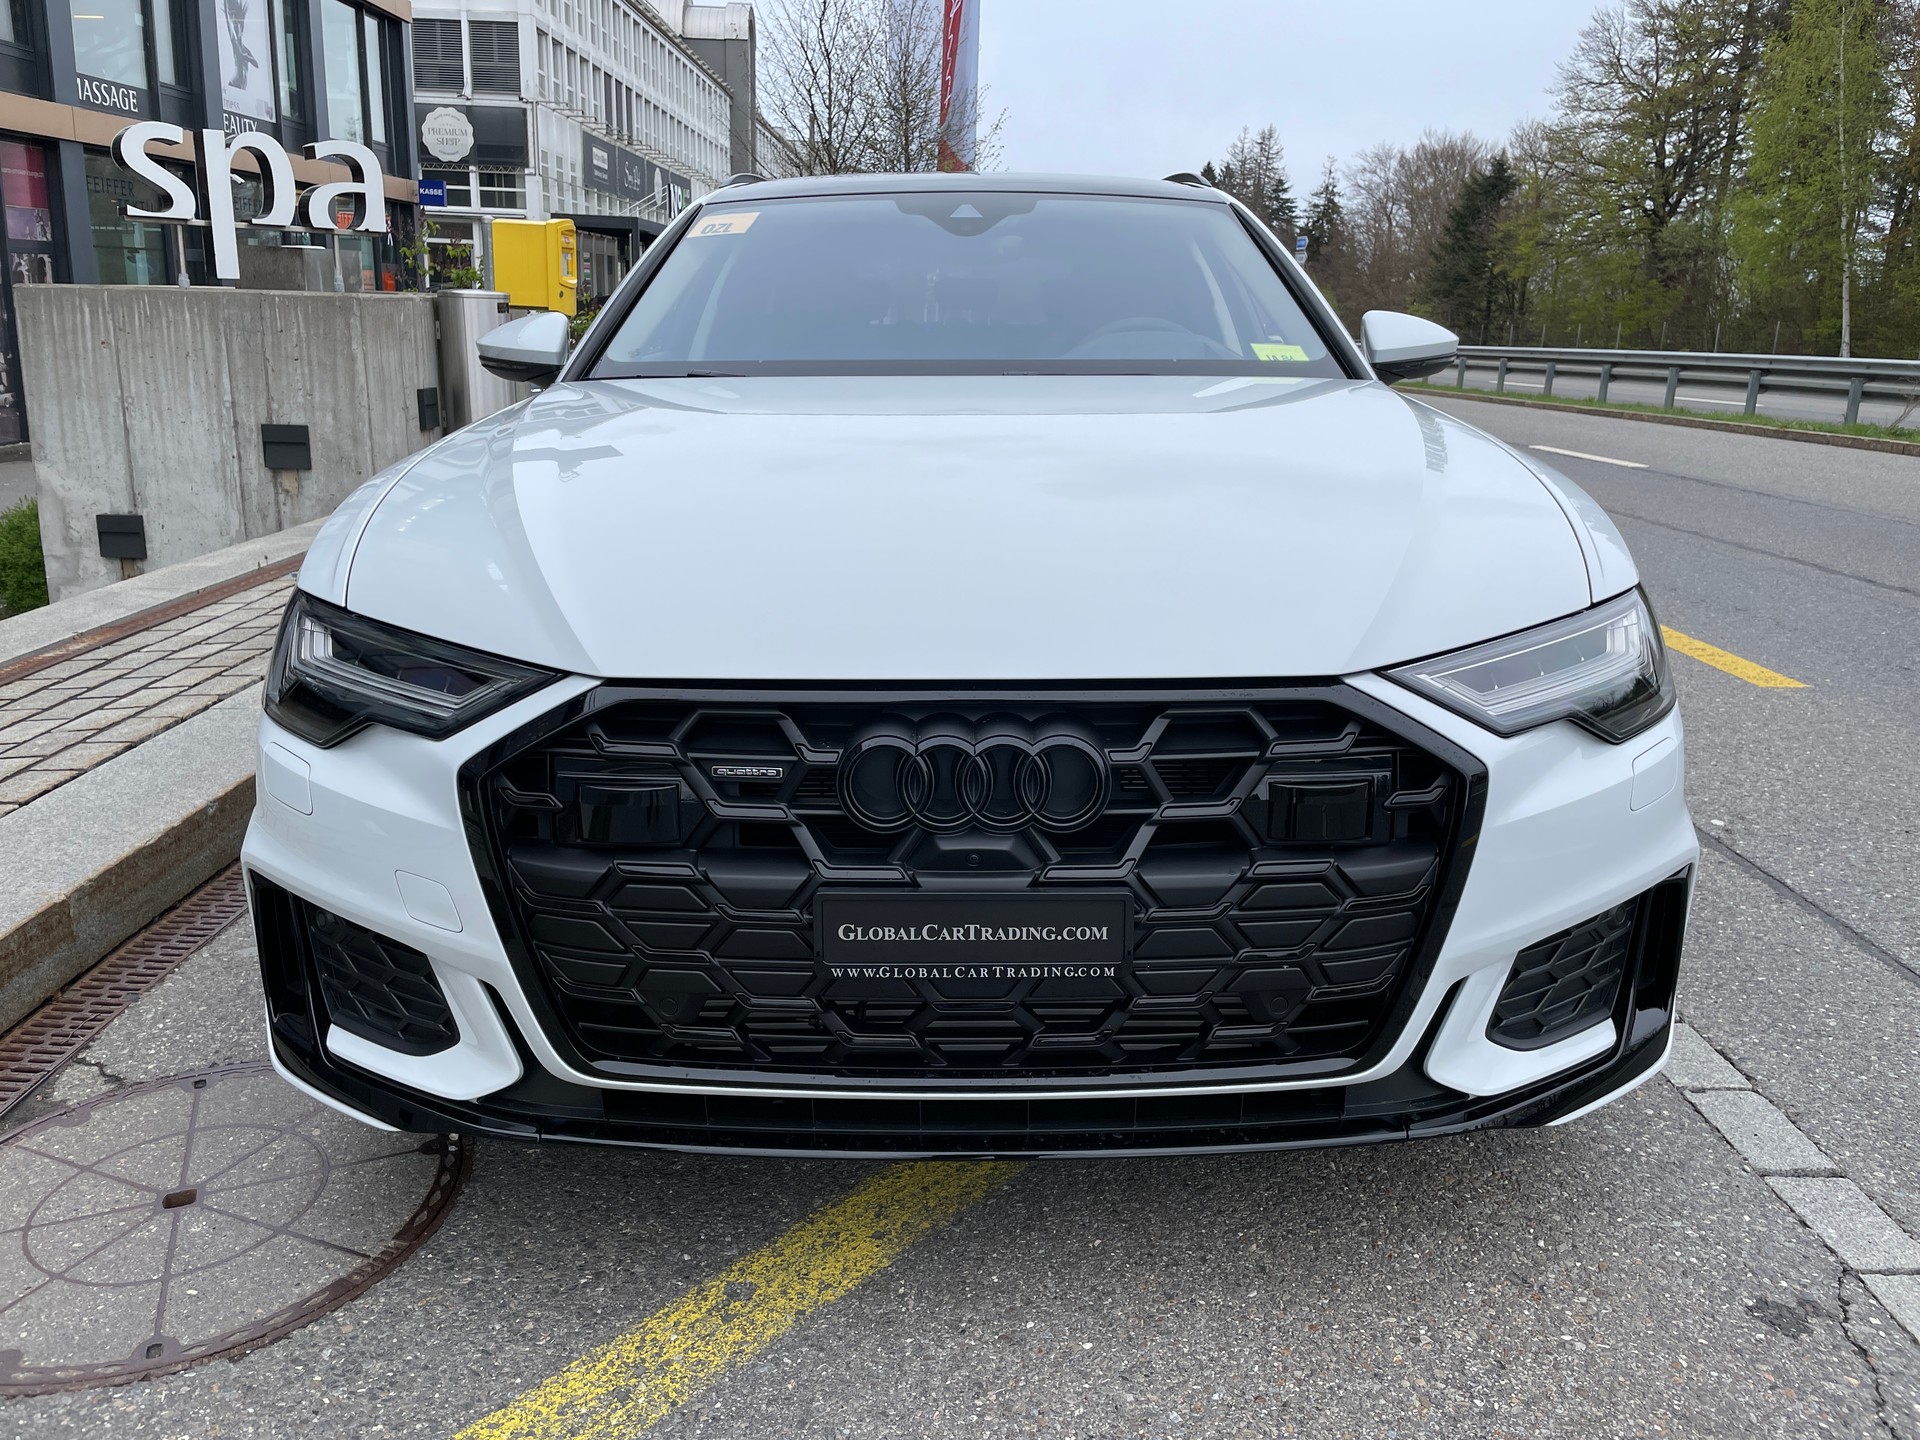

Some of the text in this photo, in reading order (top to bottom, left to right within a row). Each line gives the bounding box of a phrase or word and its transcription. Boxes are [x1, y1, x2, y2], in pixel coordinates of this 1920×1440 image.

[427, 127, 468, 137] PREMIUM
[419, 187, 443, 196] KASSE
[110, 121, 387, 280] spa
[717, 768, 777, 776] quattro
